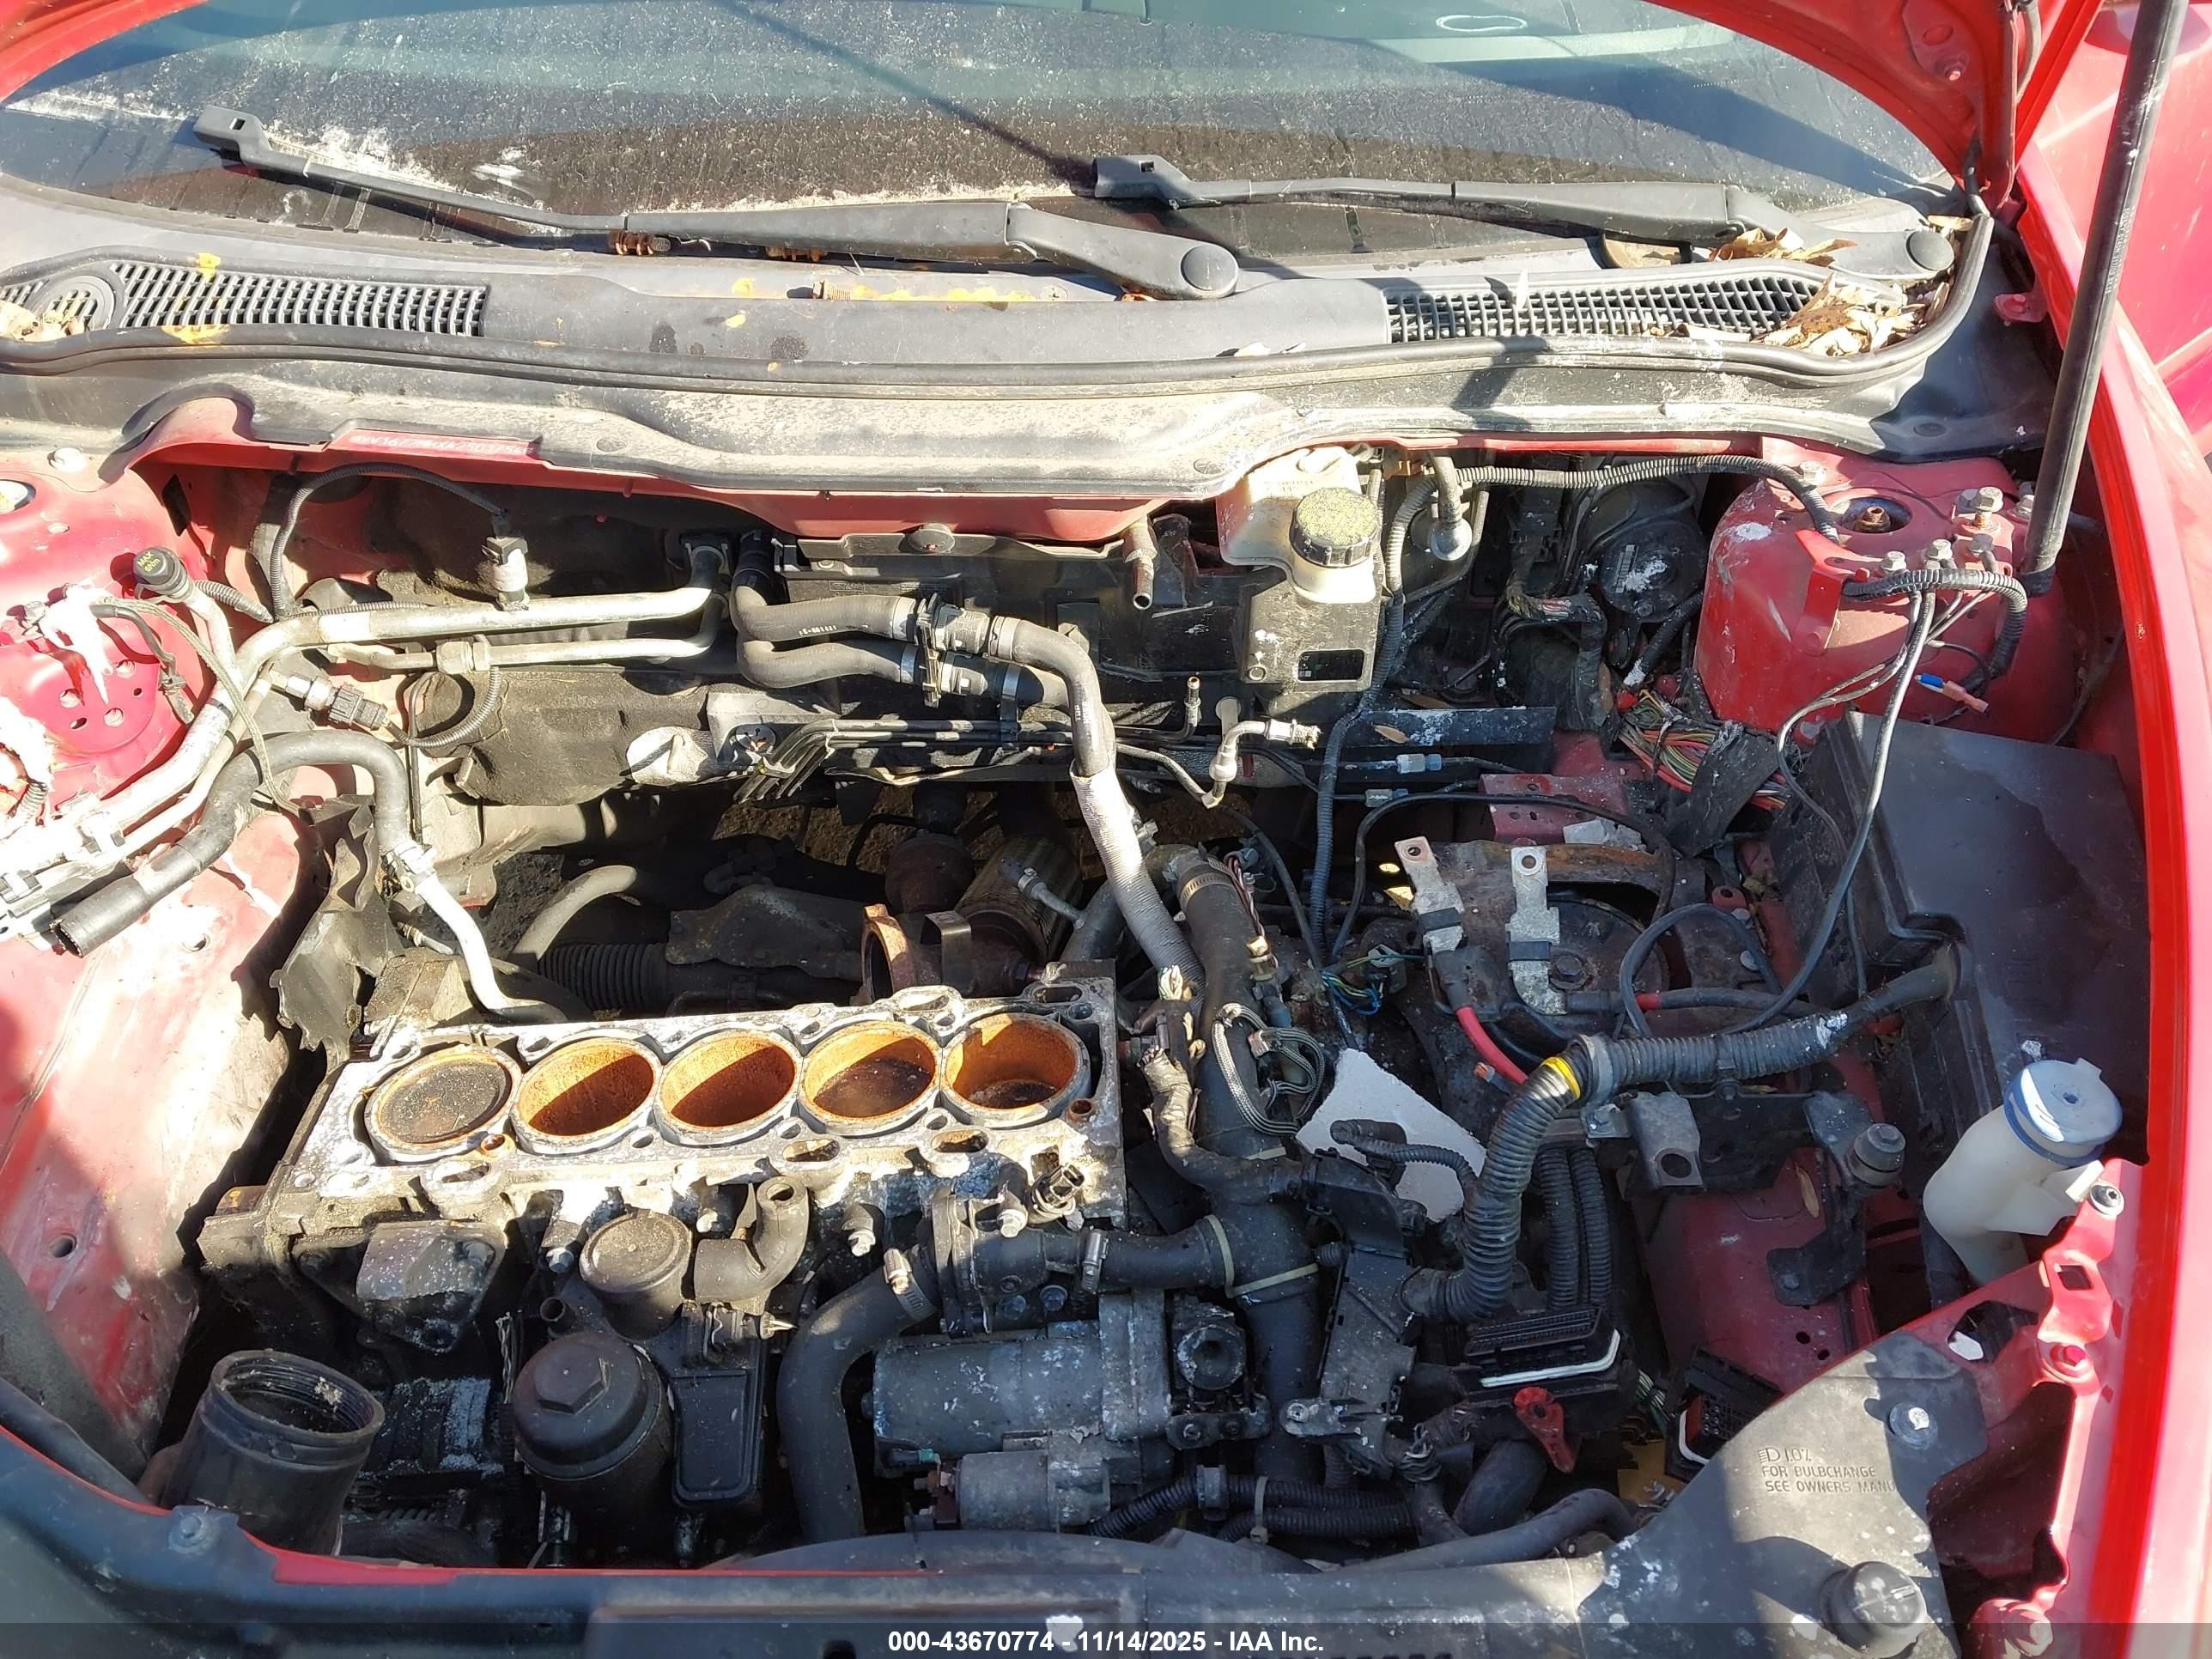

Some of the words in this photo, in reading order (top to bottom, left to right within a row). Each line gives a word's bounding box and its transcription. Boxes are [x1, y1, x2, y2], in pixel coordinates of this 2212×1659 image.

[137, 550, 155, 568] MAX
[144, 558, 161, 572] 6Nm
[1761, 1465, 1789, 1478] FOR
[1794, 1465, 1875, 1479] BULBCHANGE
[1765, 1480, 1790, 1492] SEE
[1796, 1480, 1852, 1493] OWNERS
